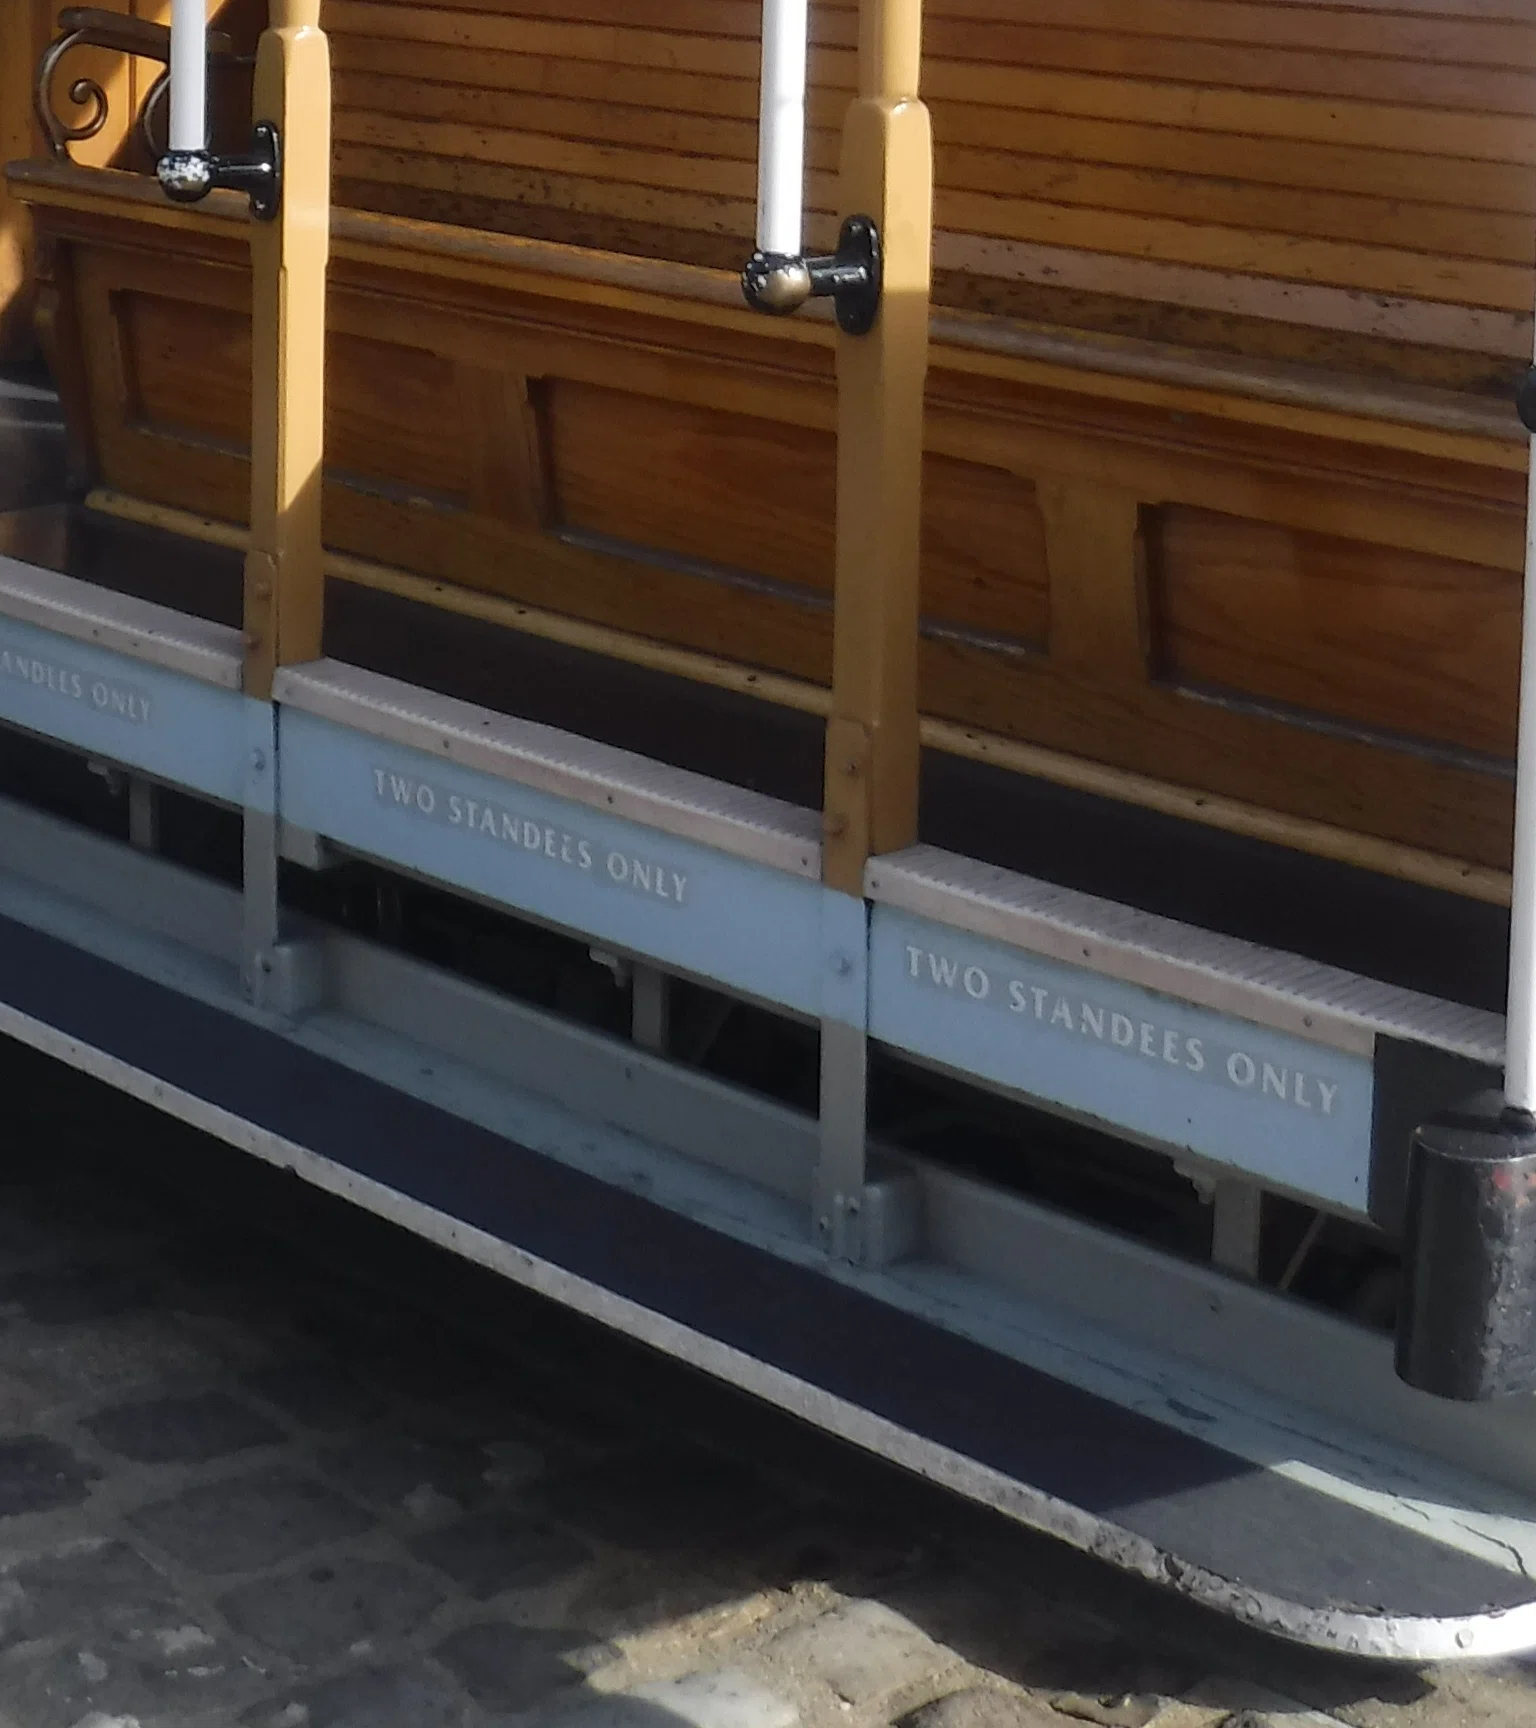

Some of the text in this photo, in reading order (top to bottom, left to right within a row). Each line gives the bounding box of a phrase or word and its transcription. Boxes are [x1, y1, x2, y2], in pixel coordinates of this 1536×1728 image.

[91, 682, 152, 722] ONLY
[373, 769, 688, 903] TWO STANDEES ONLY
[904, 945, 1340, 1115] TWO STANDEES ONLY
